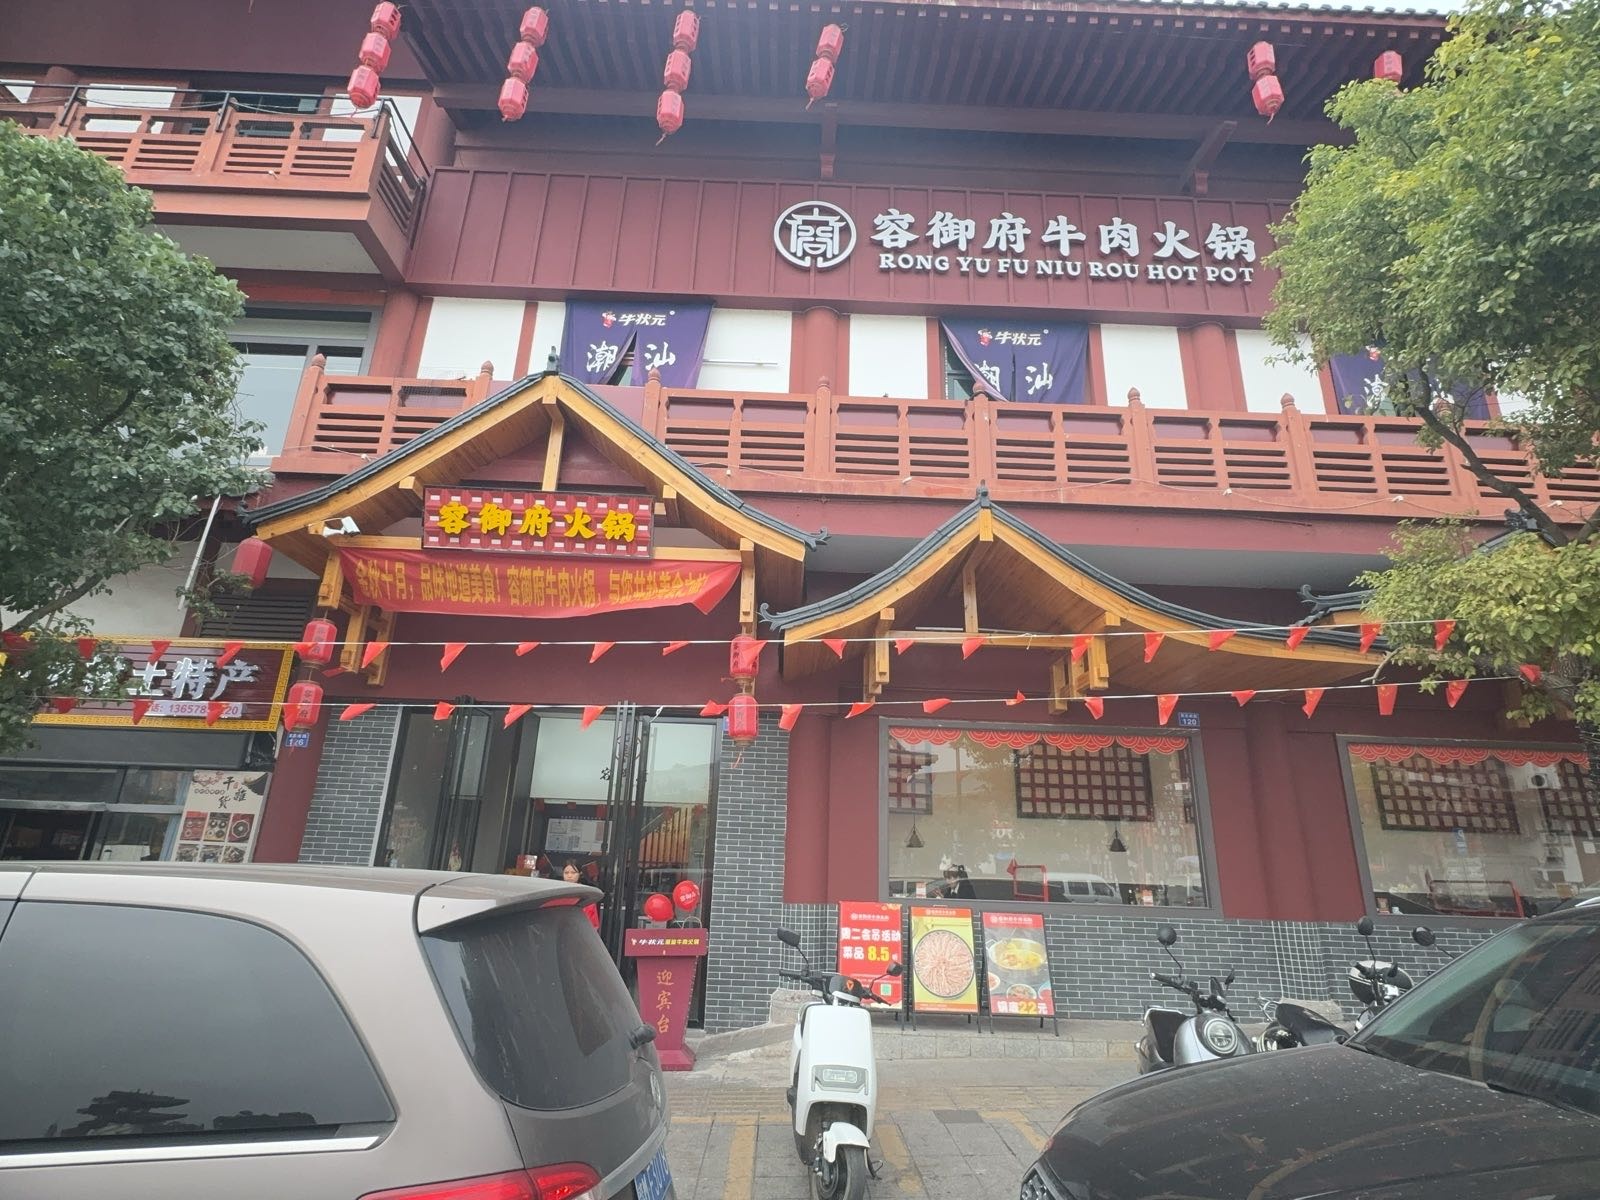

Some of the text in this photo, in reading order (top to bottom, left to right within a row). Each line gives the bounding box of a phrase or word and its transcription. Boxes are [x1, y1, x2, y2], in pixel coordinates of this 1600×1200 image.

[870, 208, 1256, 263] 容御府牛肉火锅
[879, 253, 1254, 282] RONG YU FU NIU ROU HOT POT
[437, 502, 636, 542] 容御府火锅
[656, 970, 674, 1033] 迎宾台
